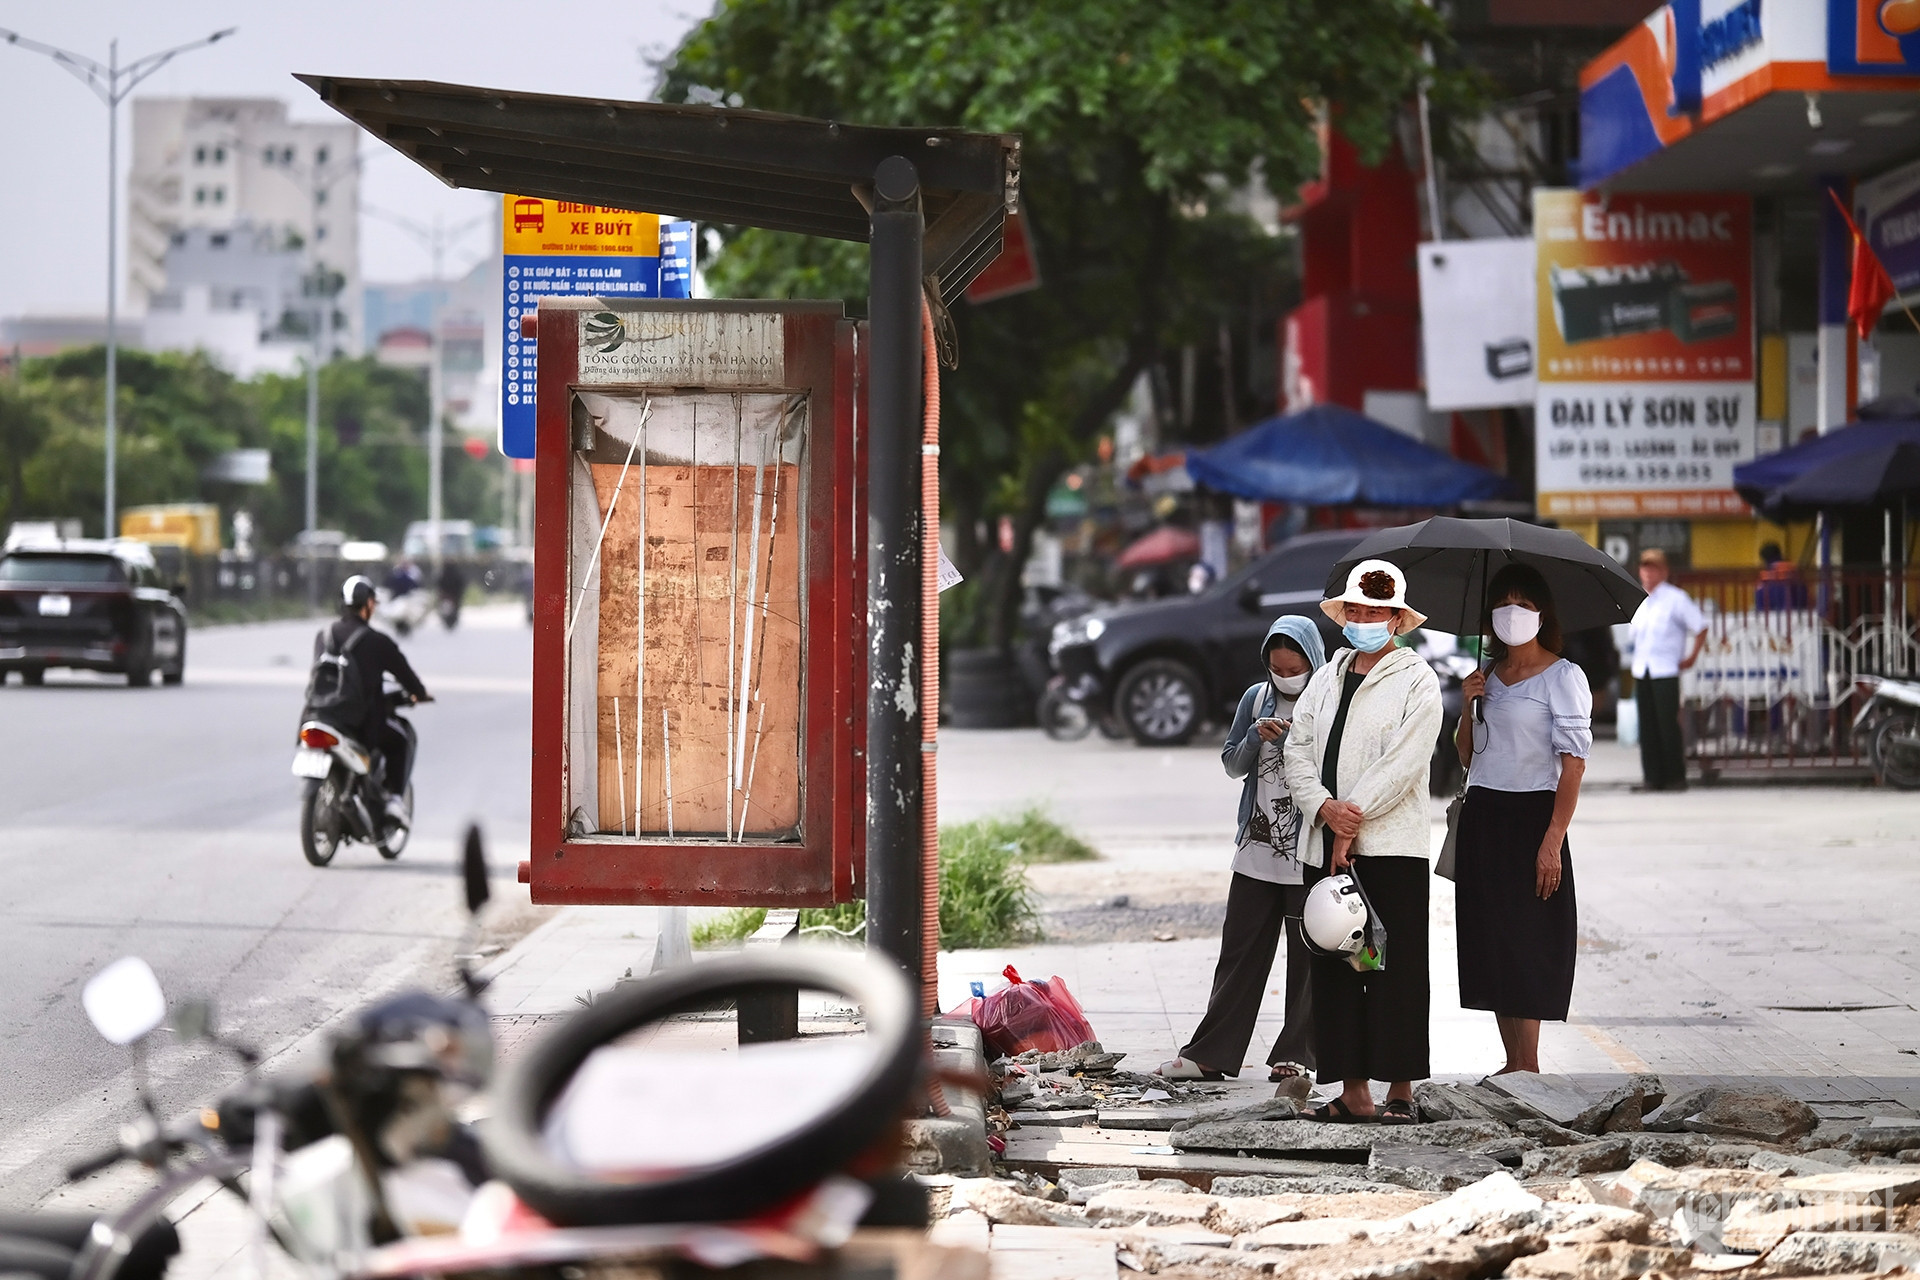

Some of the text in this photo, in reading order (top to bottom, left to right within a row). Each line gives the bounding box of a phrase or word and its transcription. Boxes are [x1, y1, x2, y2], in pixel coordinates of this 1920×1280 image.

[570, 219, 632, 236] XE BUÝT
[1582, 202, 1732, 241] Enimac
[523, 267, 534, 277] BX
[577, 268, 588, 278] BX
[589, 268, 603, 278] GIA
[585, 351, 619, 365] TỔNG
[622, 353, 658, 365] CÔNG
[662, 355, 676, 364] TY
[730, 353, 747, 365] HÀ
[751, 354, 772, 367] NỘI
[608, 366, 620, 375] dây
[1604, 391, 1634, 429] LÝ
[1643, 394, 1696, 429] SƠN
